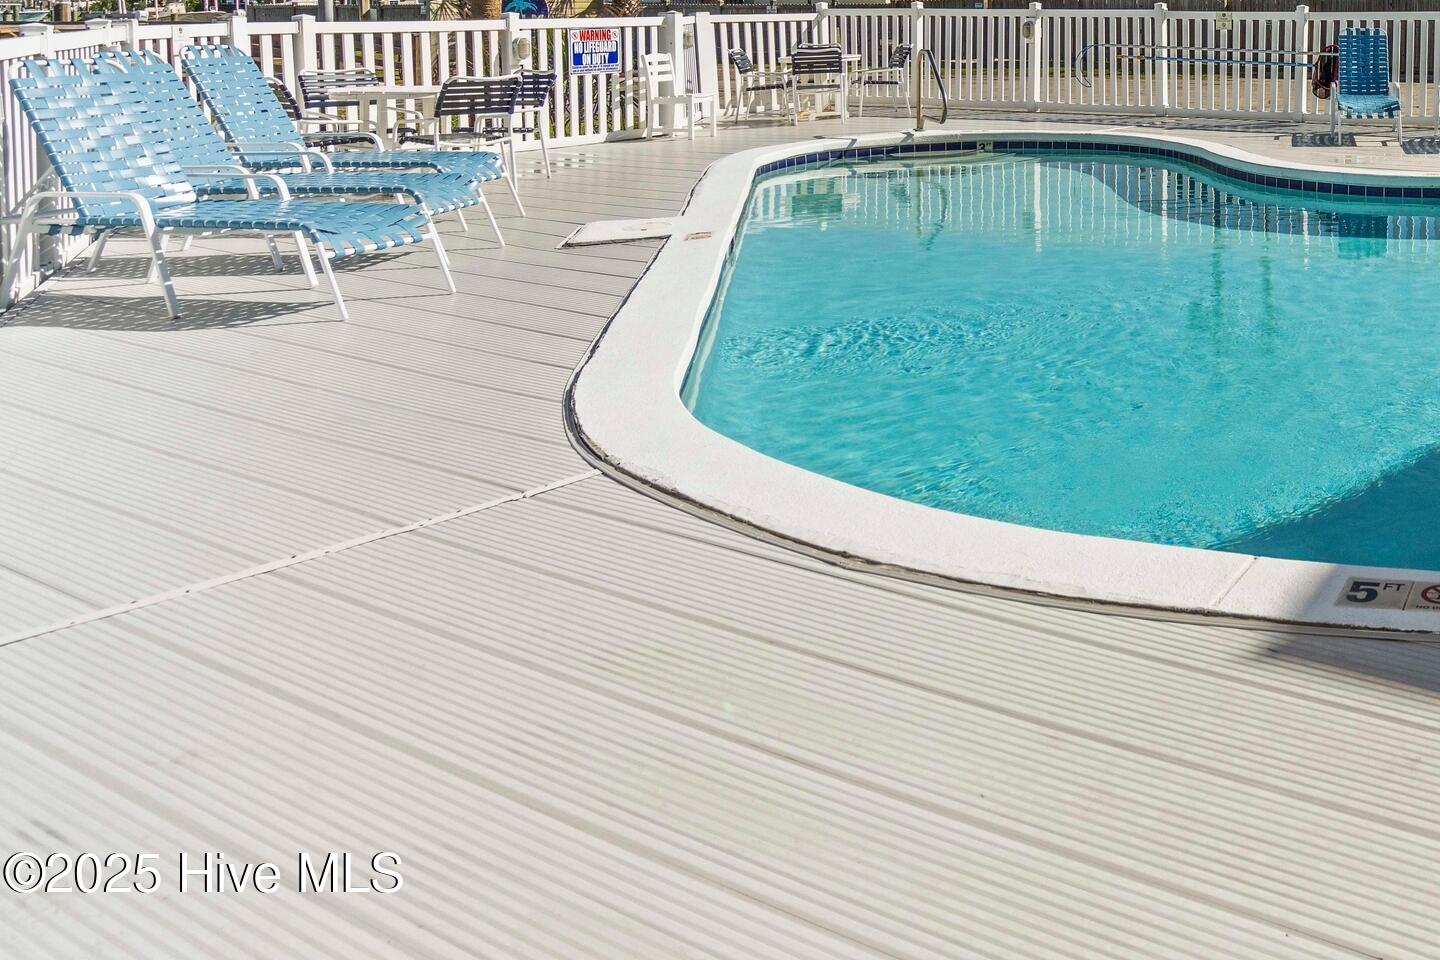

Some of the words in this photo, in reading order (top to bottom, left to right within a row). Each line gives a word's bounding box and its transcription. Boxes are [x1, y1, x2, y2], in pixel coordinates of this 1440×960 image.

[579, 29, 611, 41] WARNING
[573, 42, 583, 54] NO
[584, 40, 617, 54] LIFEGUARD
[582, 53, 591, 65] ON
[592, 52, 609, 65] DUTY
[1346, 581, 1380, 603] 5
[1383, 583, 1406, 592] FT
